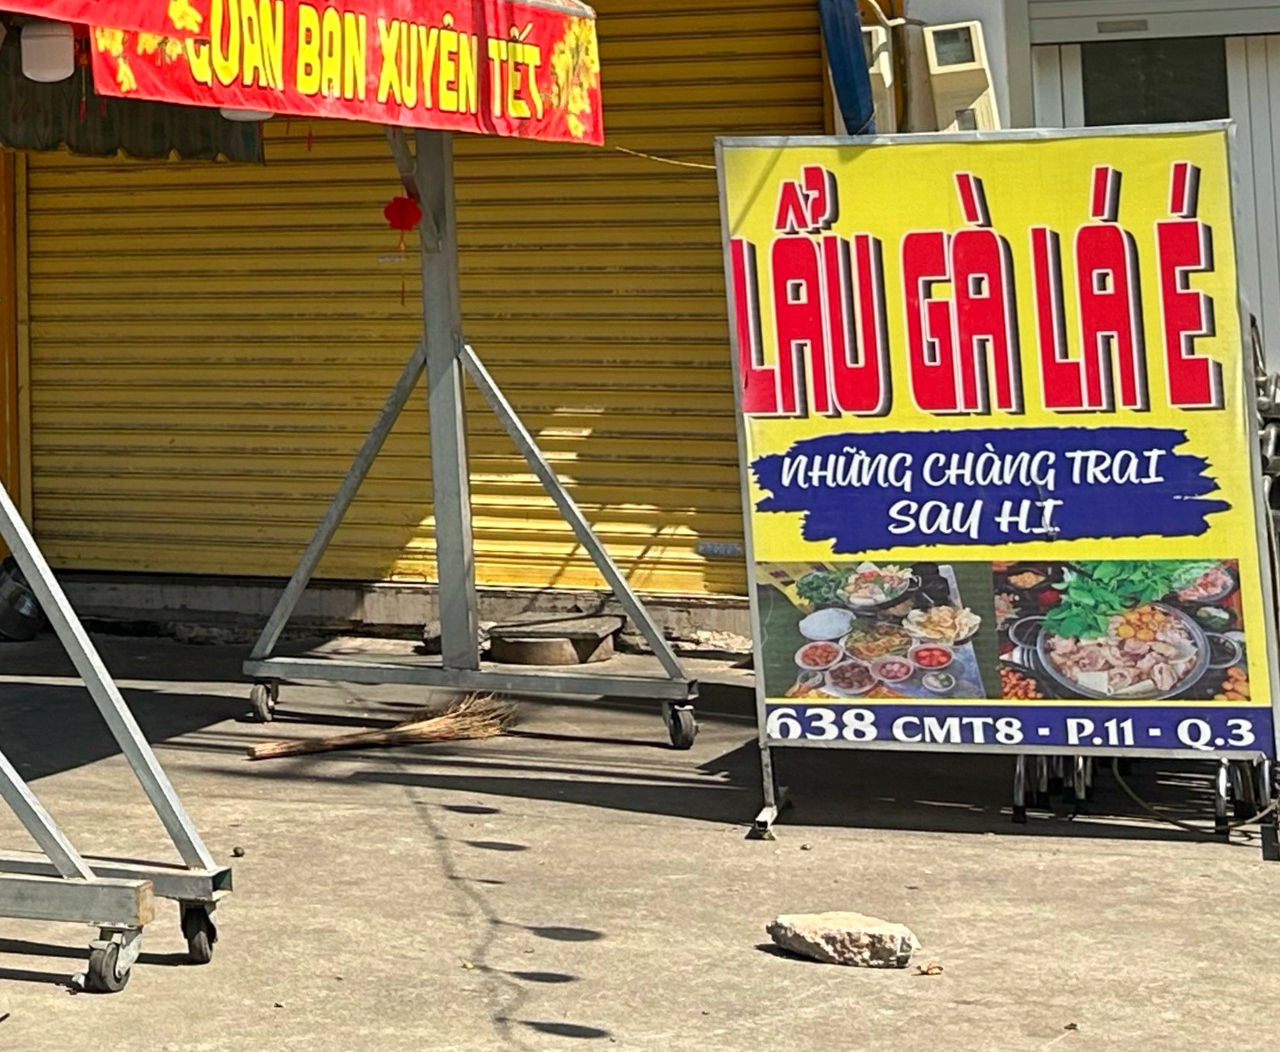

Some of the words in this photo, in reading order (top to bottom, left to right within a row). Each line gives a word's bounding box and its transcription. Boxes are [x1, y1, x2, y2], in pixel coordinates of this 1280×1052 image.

[376, 12, 479, 115] XUYÊN
[487, 23, 544, 120] TẾT
[731, 164, 893, 418] LẨU
[900, 171, 1025, 416] GÀ
[1028, 164, 1149, 414] LÁ
[1154, 161, 1226, 412] É
[780, 446, 913, 488] NHỮNG
[922, 444, 1062, 492] CHÀNG
[1064, 447, 1166, 486] TRAI
[888, 498, 983, 538] SAY
[994, 498, 1062, 536] HI
[766, 707, 878, 743] 638
[891, 715, 1024, 745] CMT8
[1066, 720, 1136, 746] P.11
[1176, 717, 1257, 751] Q.3
